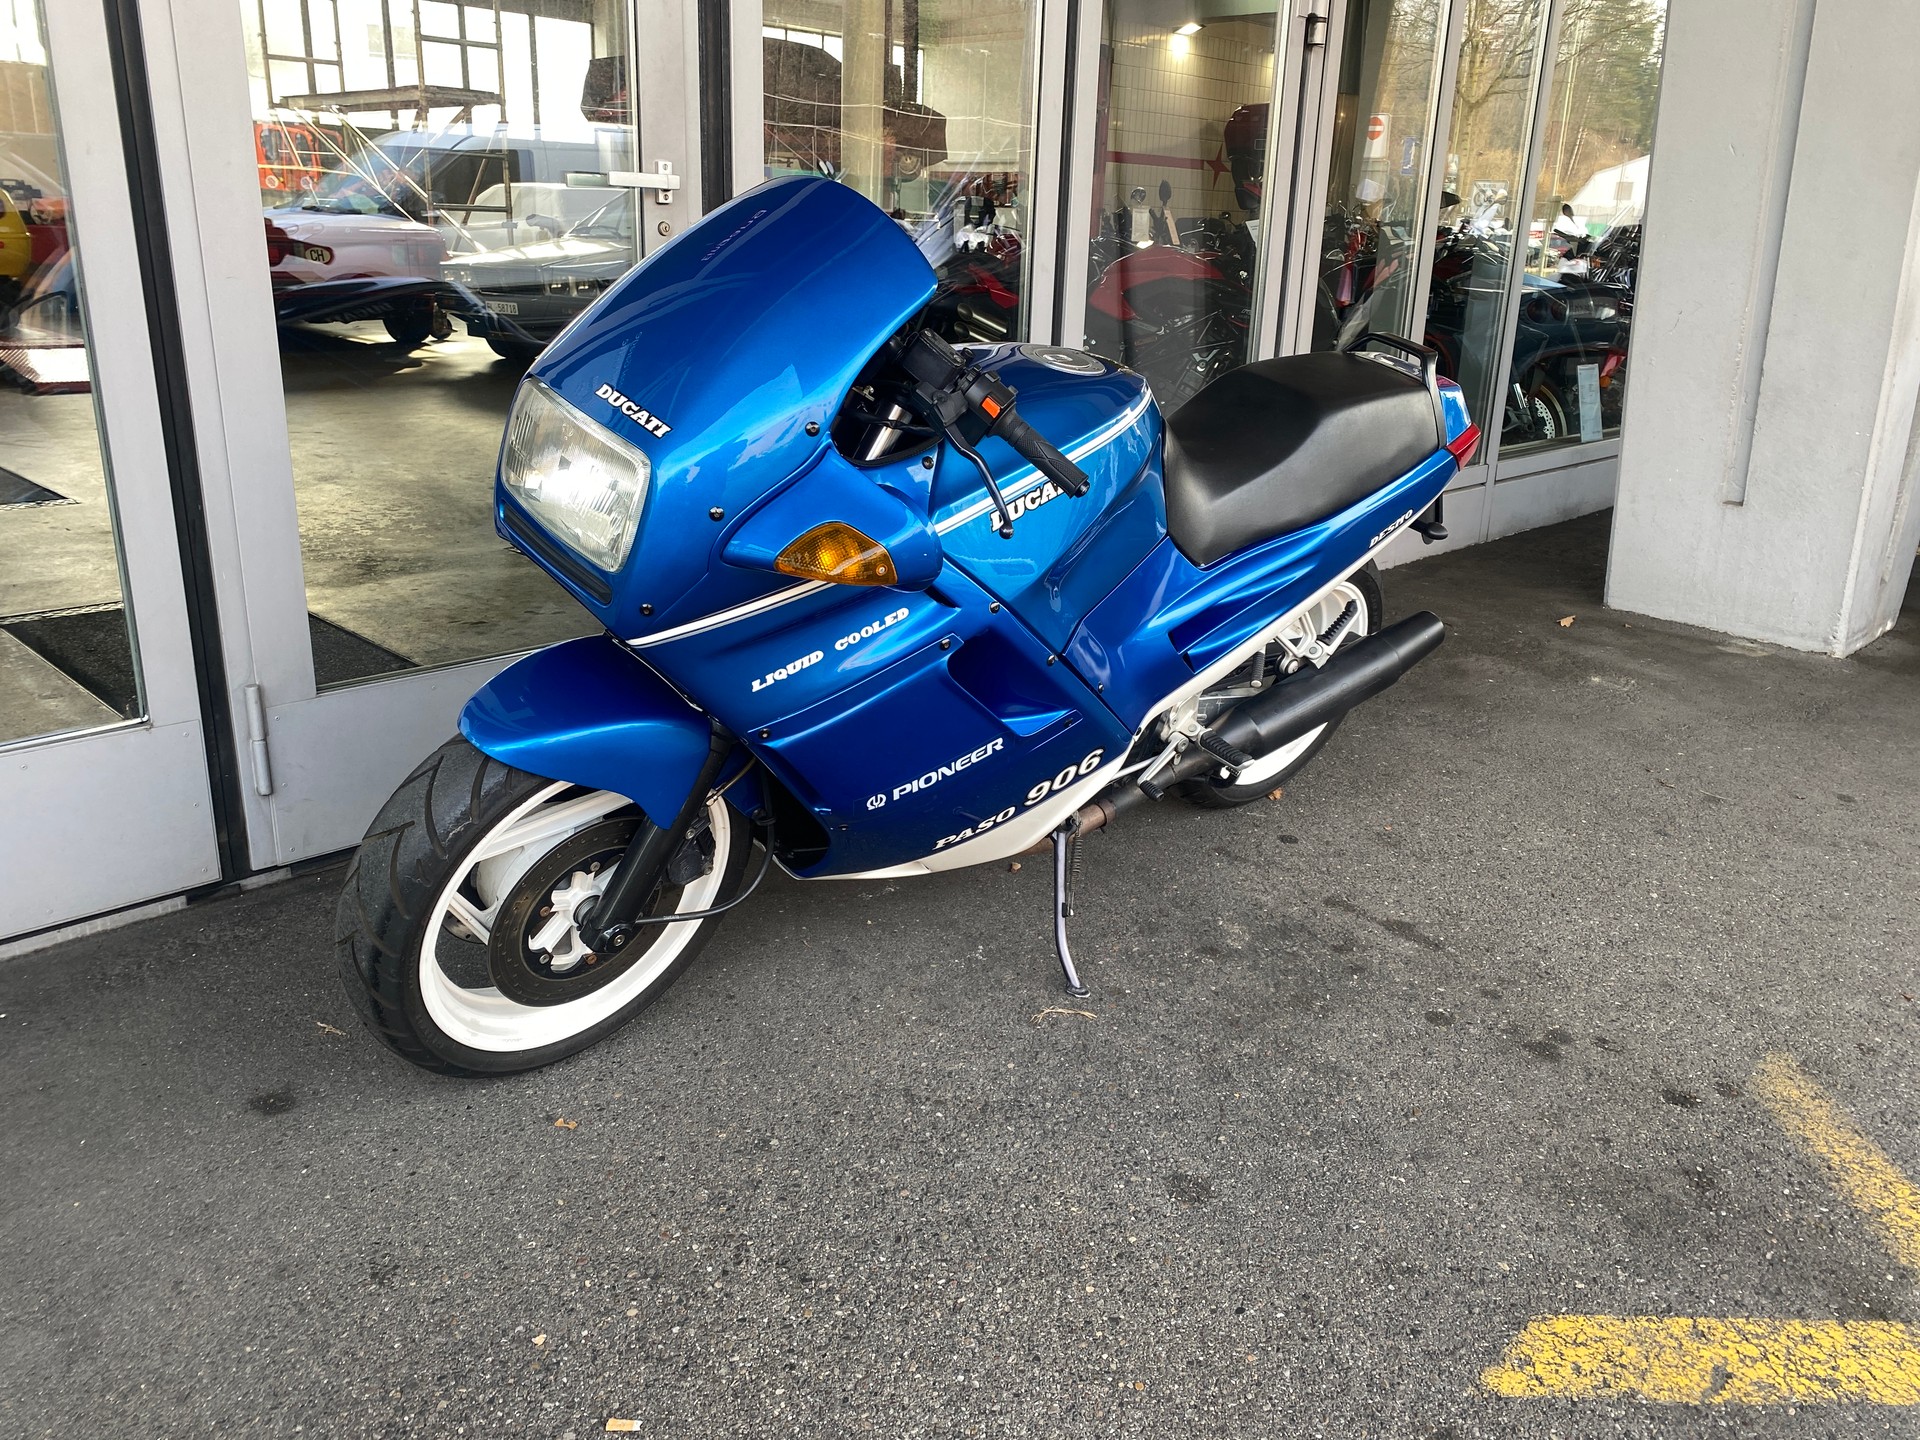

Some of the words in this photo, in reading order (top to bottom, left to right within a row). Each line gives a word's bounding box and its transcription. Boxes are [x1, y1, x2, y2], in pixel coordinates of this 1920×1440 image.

[310, 249, 325, 262] CH
[594, 382, 673, 439] DUCATI
[989, 480, 1065, 533] DUCA
[1368, 509, 1413, 549] DESMO
[752, 650, 824, 692] LIQUID
[834, 607, 909, 650] COOLED
[892, 737, 1004, 801] PIONEER
[931, 805, 1016, 850] PASO
[1023, 747, 1104, 807] 906
